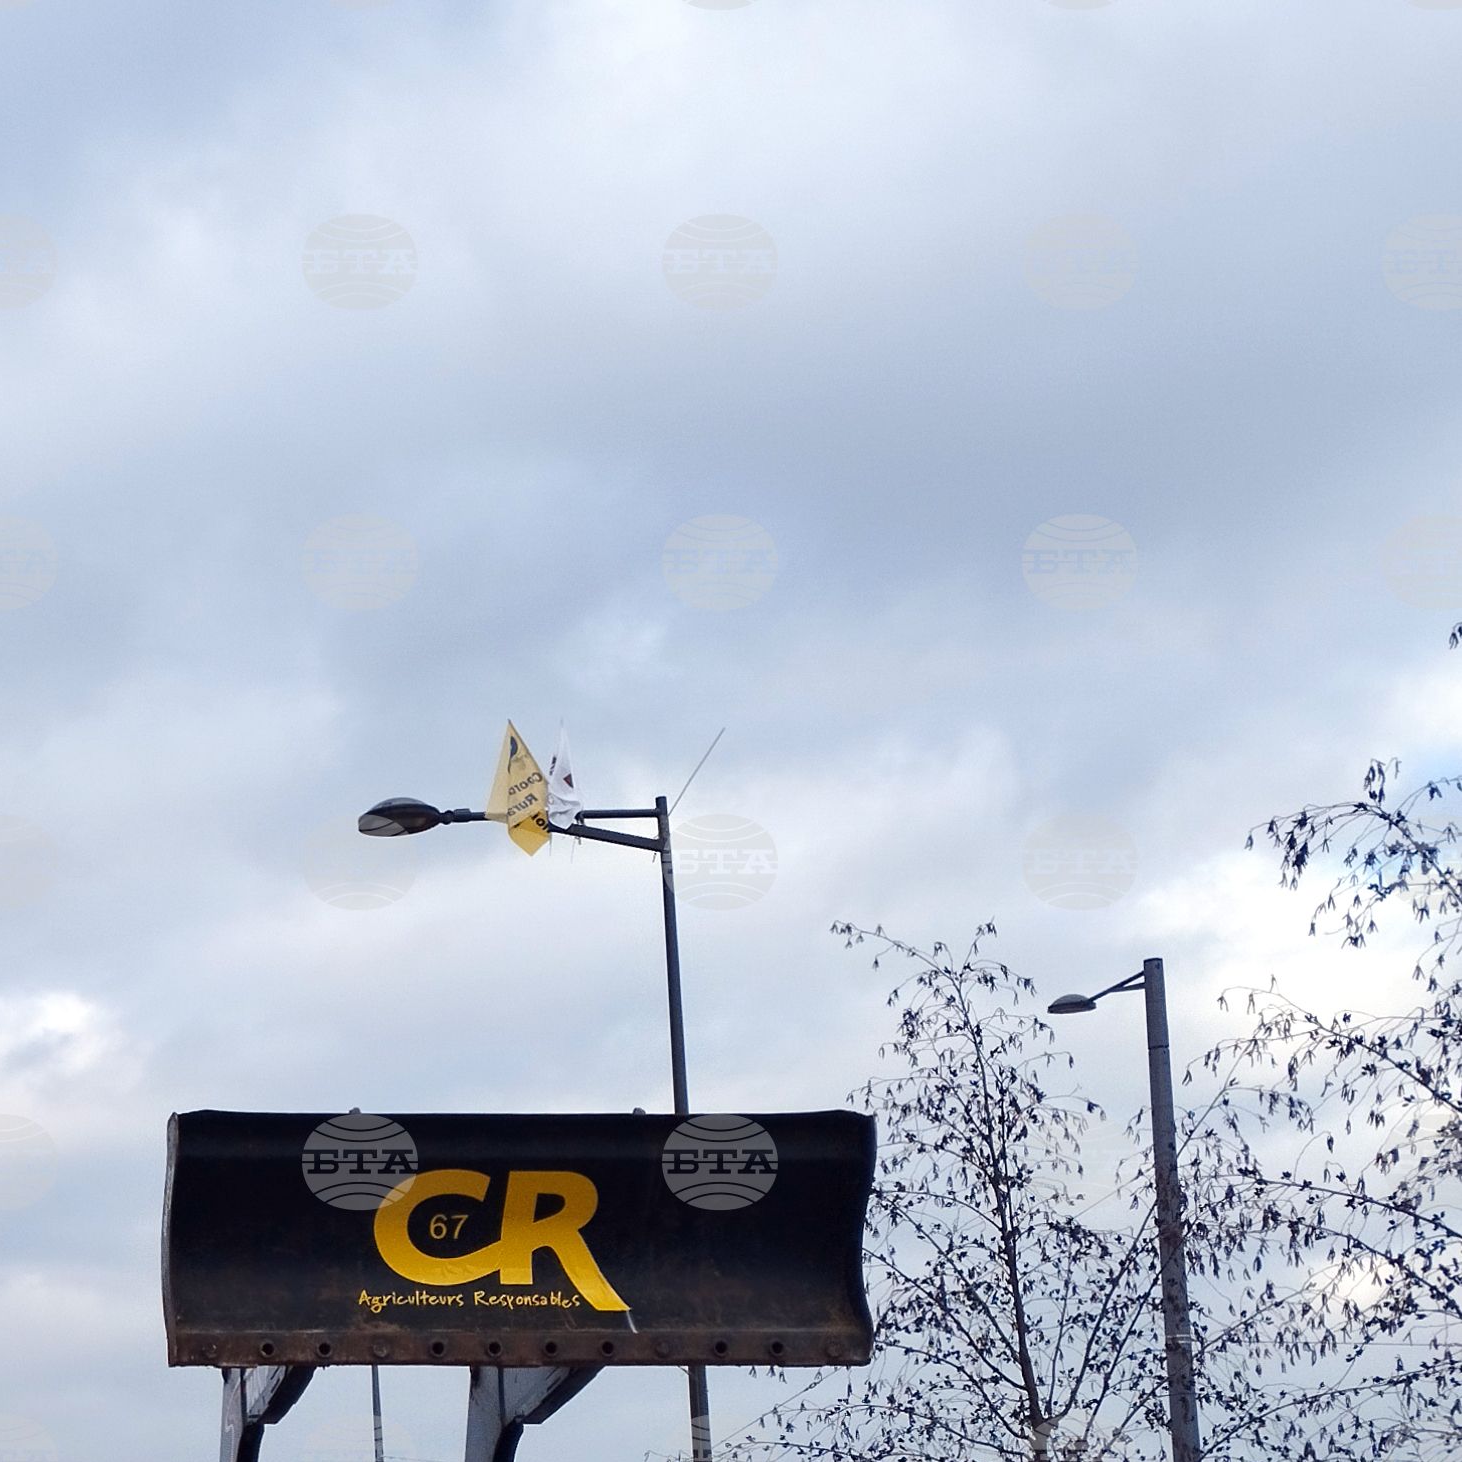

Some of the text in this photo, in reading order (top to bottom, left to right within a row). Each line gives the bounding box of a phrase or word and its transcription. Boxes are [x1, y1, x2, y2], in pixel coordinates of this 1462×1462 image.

[429, 1214, 469, 1240] 67
[358, 1289, 580, 1313] Agriculteurs Responsables
